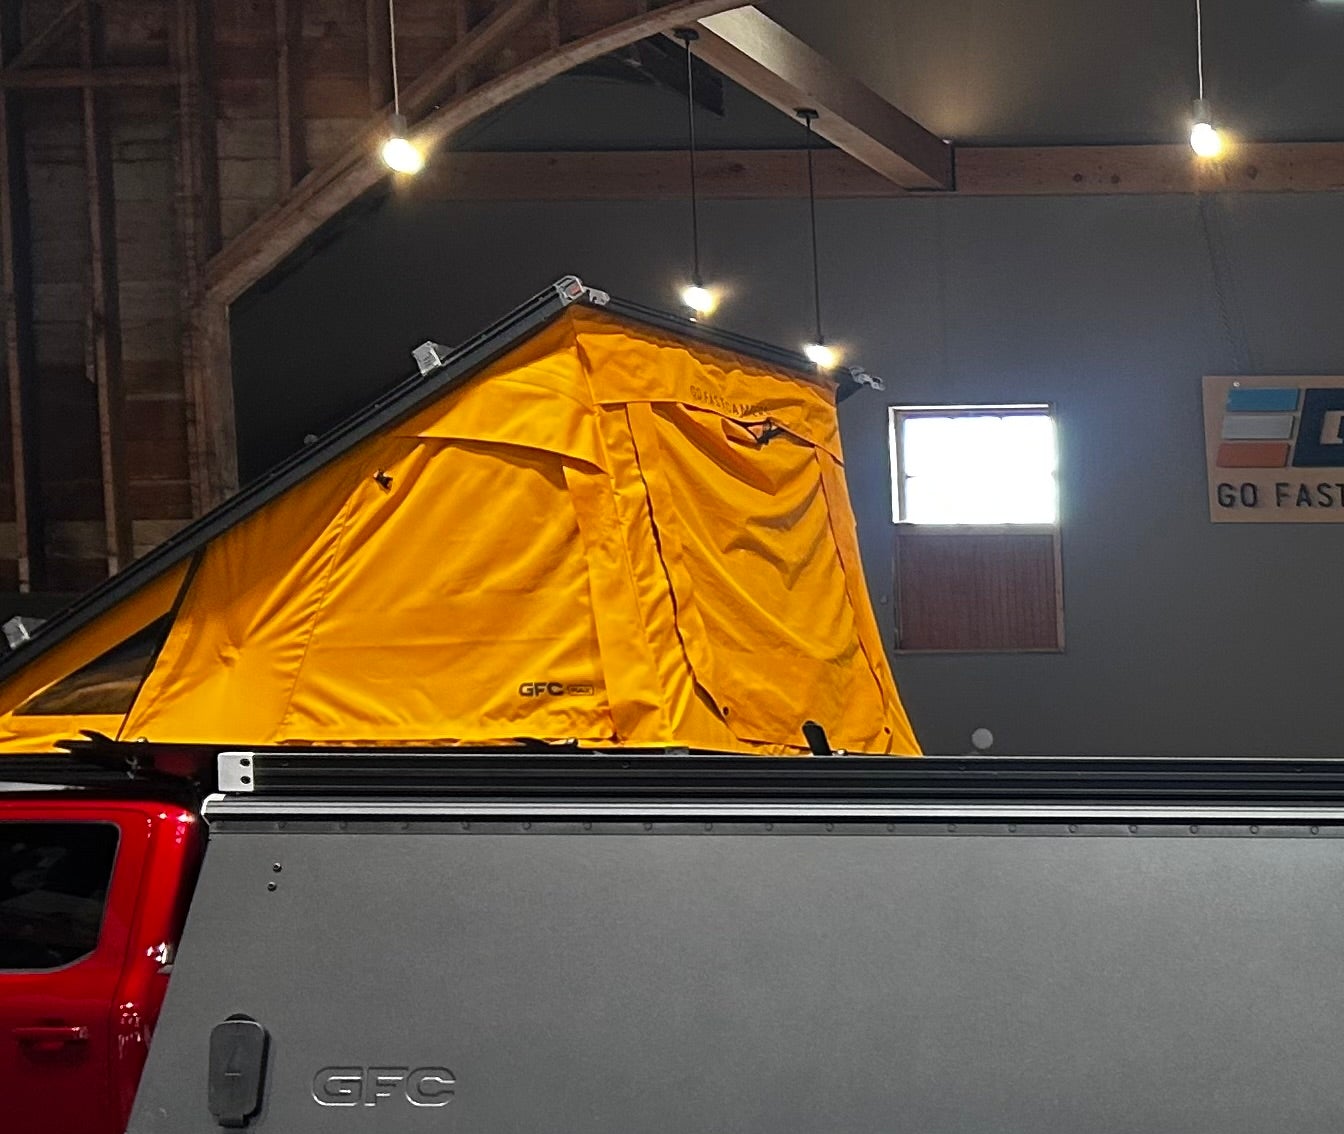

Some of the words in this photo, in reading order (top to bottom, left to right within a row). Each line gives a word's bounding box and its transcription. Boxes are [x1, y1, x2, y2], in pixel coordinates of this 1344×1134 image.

[1217, 482, 1258, 508] GO
[518, 682, 564, 697] GFC
[311, 1066, 457, 1107] GFC
